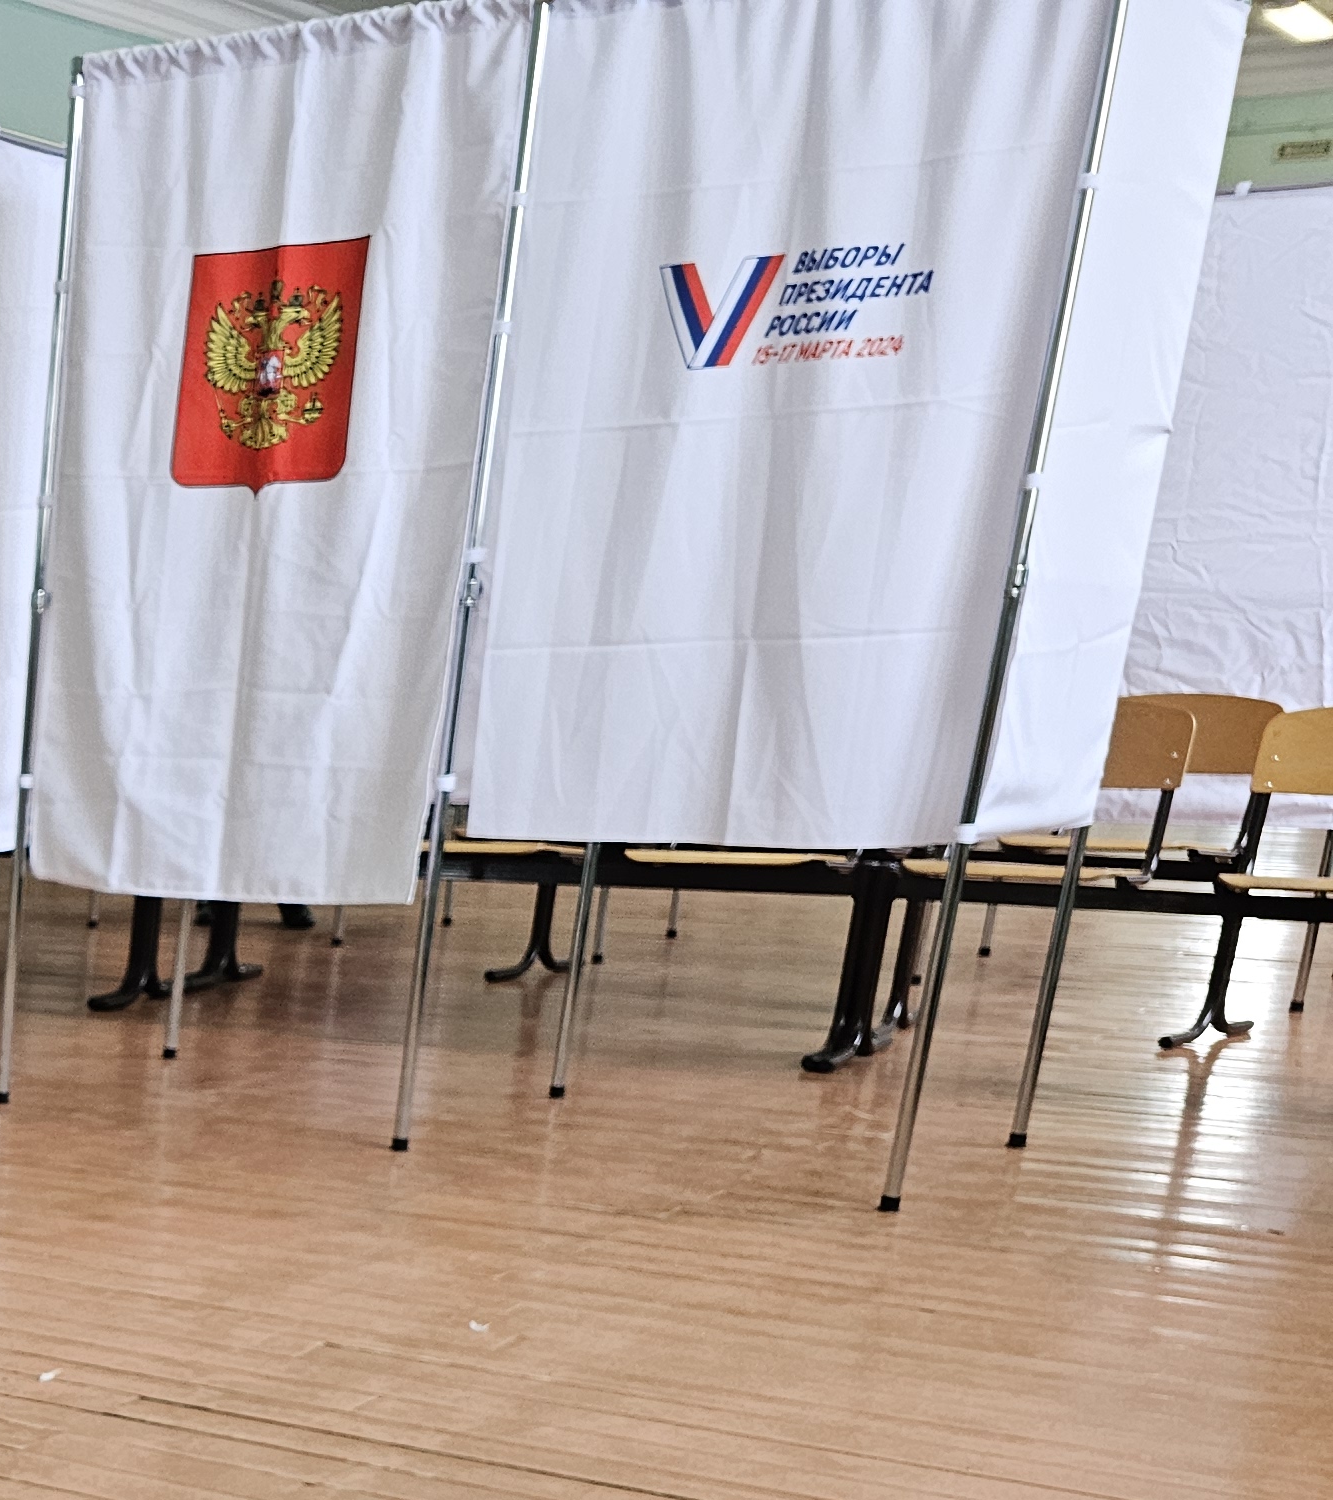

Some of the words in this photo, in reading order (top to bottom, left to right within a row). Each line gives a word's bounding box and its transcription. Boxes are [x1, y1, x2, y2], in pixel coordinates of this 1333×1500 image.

[792, 242, 906, 275] ВЫБОРЫ
[779, 269, 934, 306] ПРЕЗИДЕНТА
[763, 309, 859, 338] РОССИИ
[796, 338, 855, 362] МАРТА
[855, 334, 905, 358] 2024
